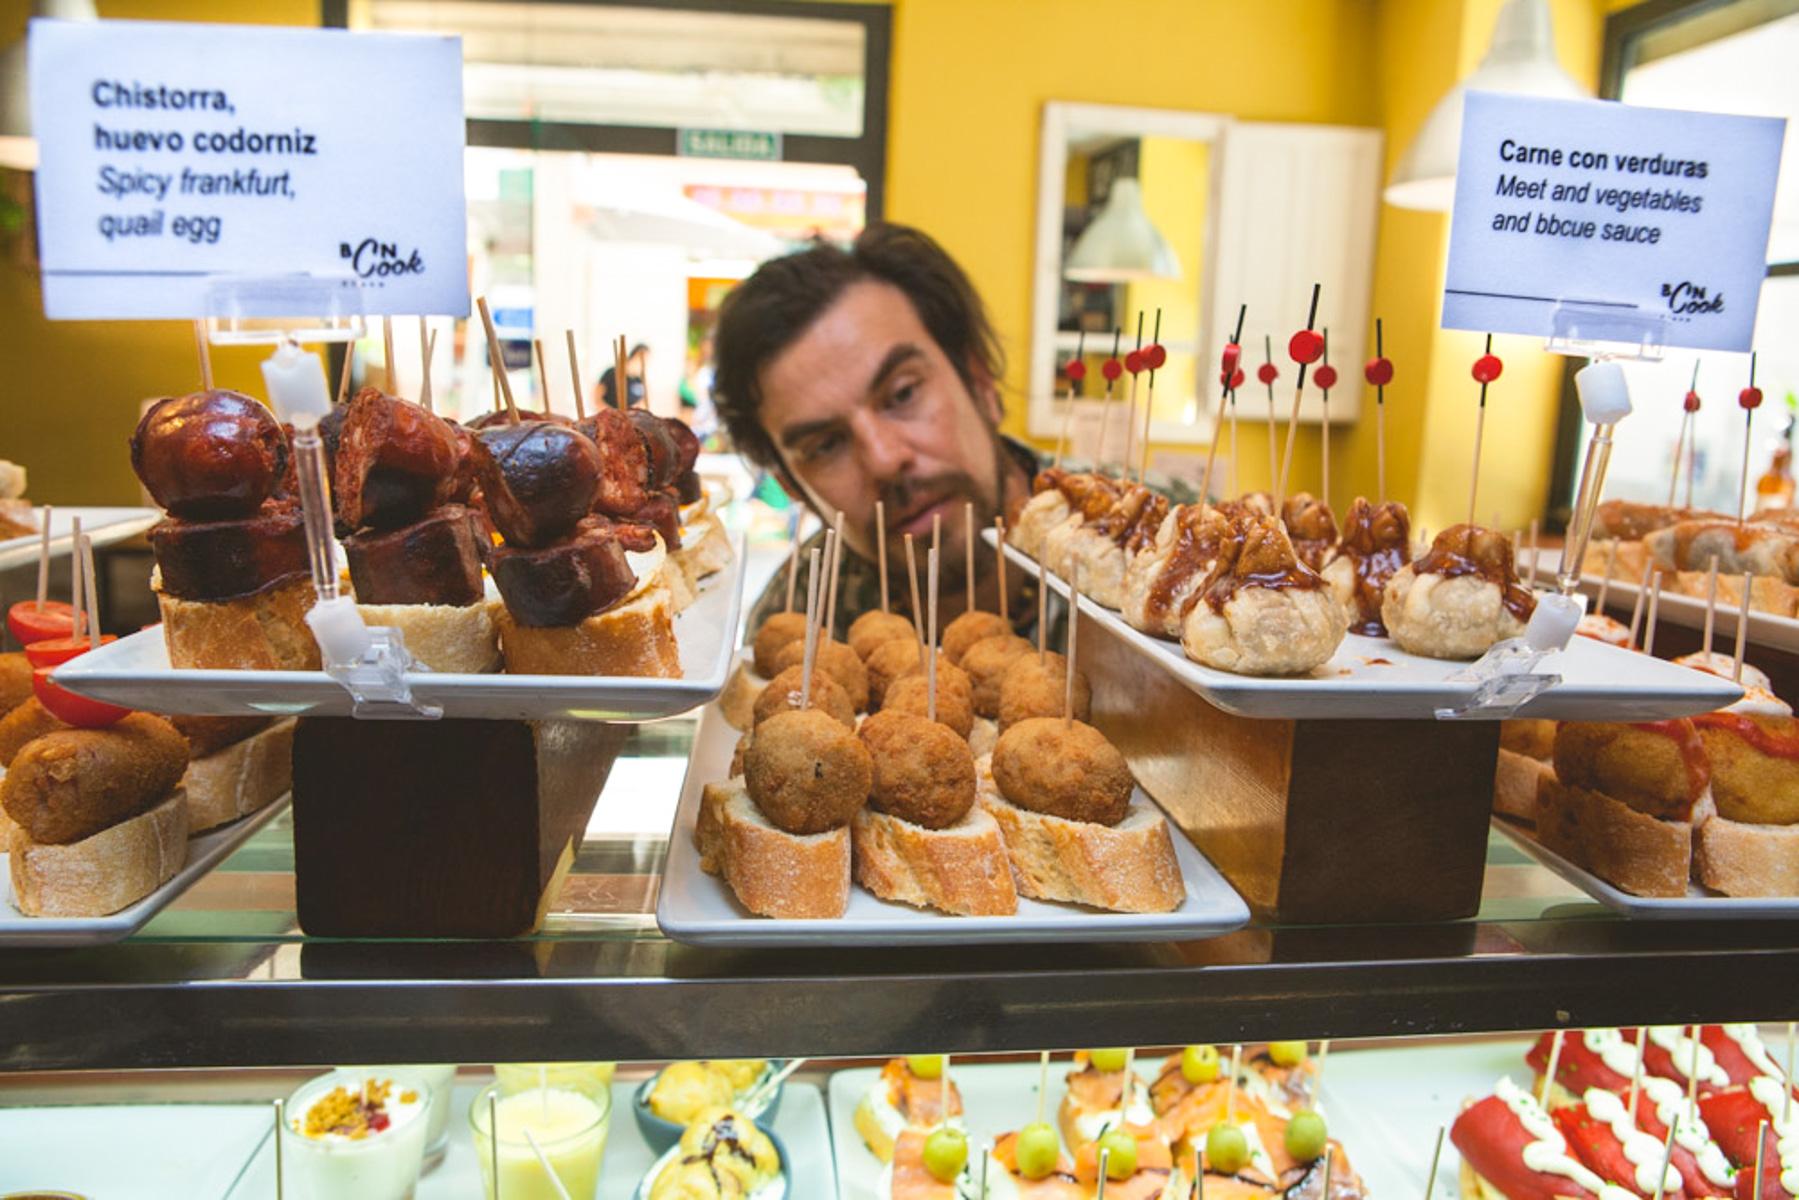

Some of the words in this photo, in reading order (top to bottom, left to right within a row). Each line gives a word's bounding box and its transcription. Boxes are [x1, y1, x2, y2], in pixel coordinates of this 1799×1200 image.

[91, 79, 236, 115] Chistorra,
[93, 123, 185, 153] huevo
[192, 127, 319, 156] codorniz
[1499, 139, 1563, 166] Carne
[1568, 150, 1609, 171] con
[1614, 153, 1709, 180] verduras
[97, 165, 173, 202] Spicy
[180, 166, 297, 201] frankfurt,
[1496, 174, 1547, 200] Meet
[1551, 182, 1591, 204] and
[1595, 187, 1704, 214] vegetables
[98, 210, 165, 241] quail
[171, 214, 222, 245] egg
[1492, 212, 1532, 234] and
[1535, 213, 1597, 239] bbcue
[1601, 223, 1662, 245] sauce
